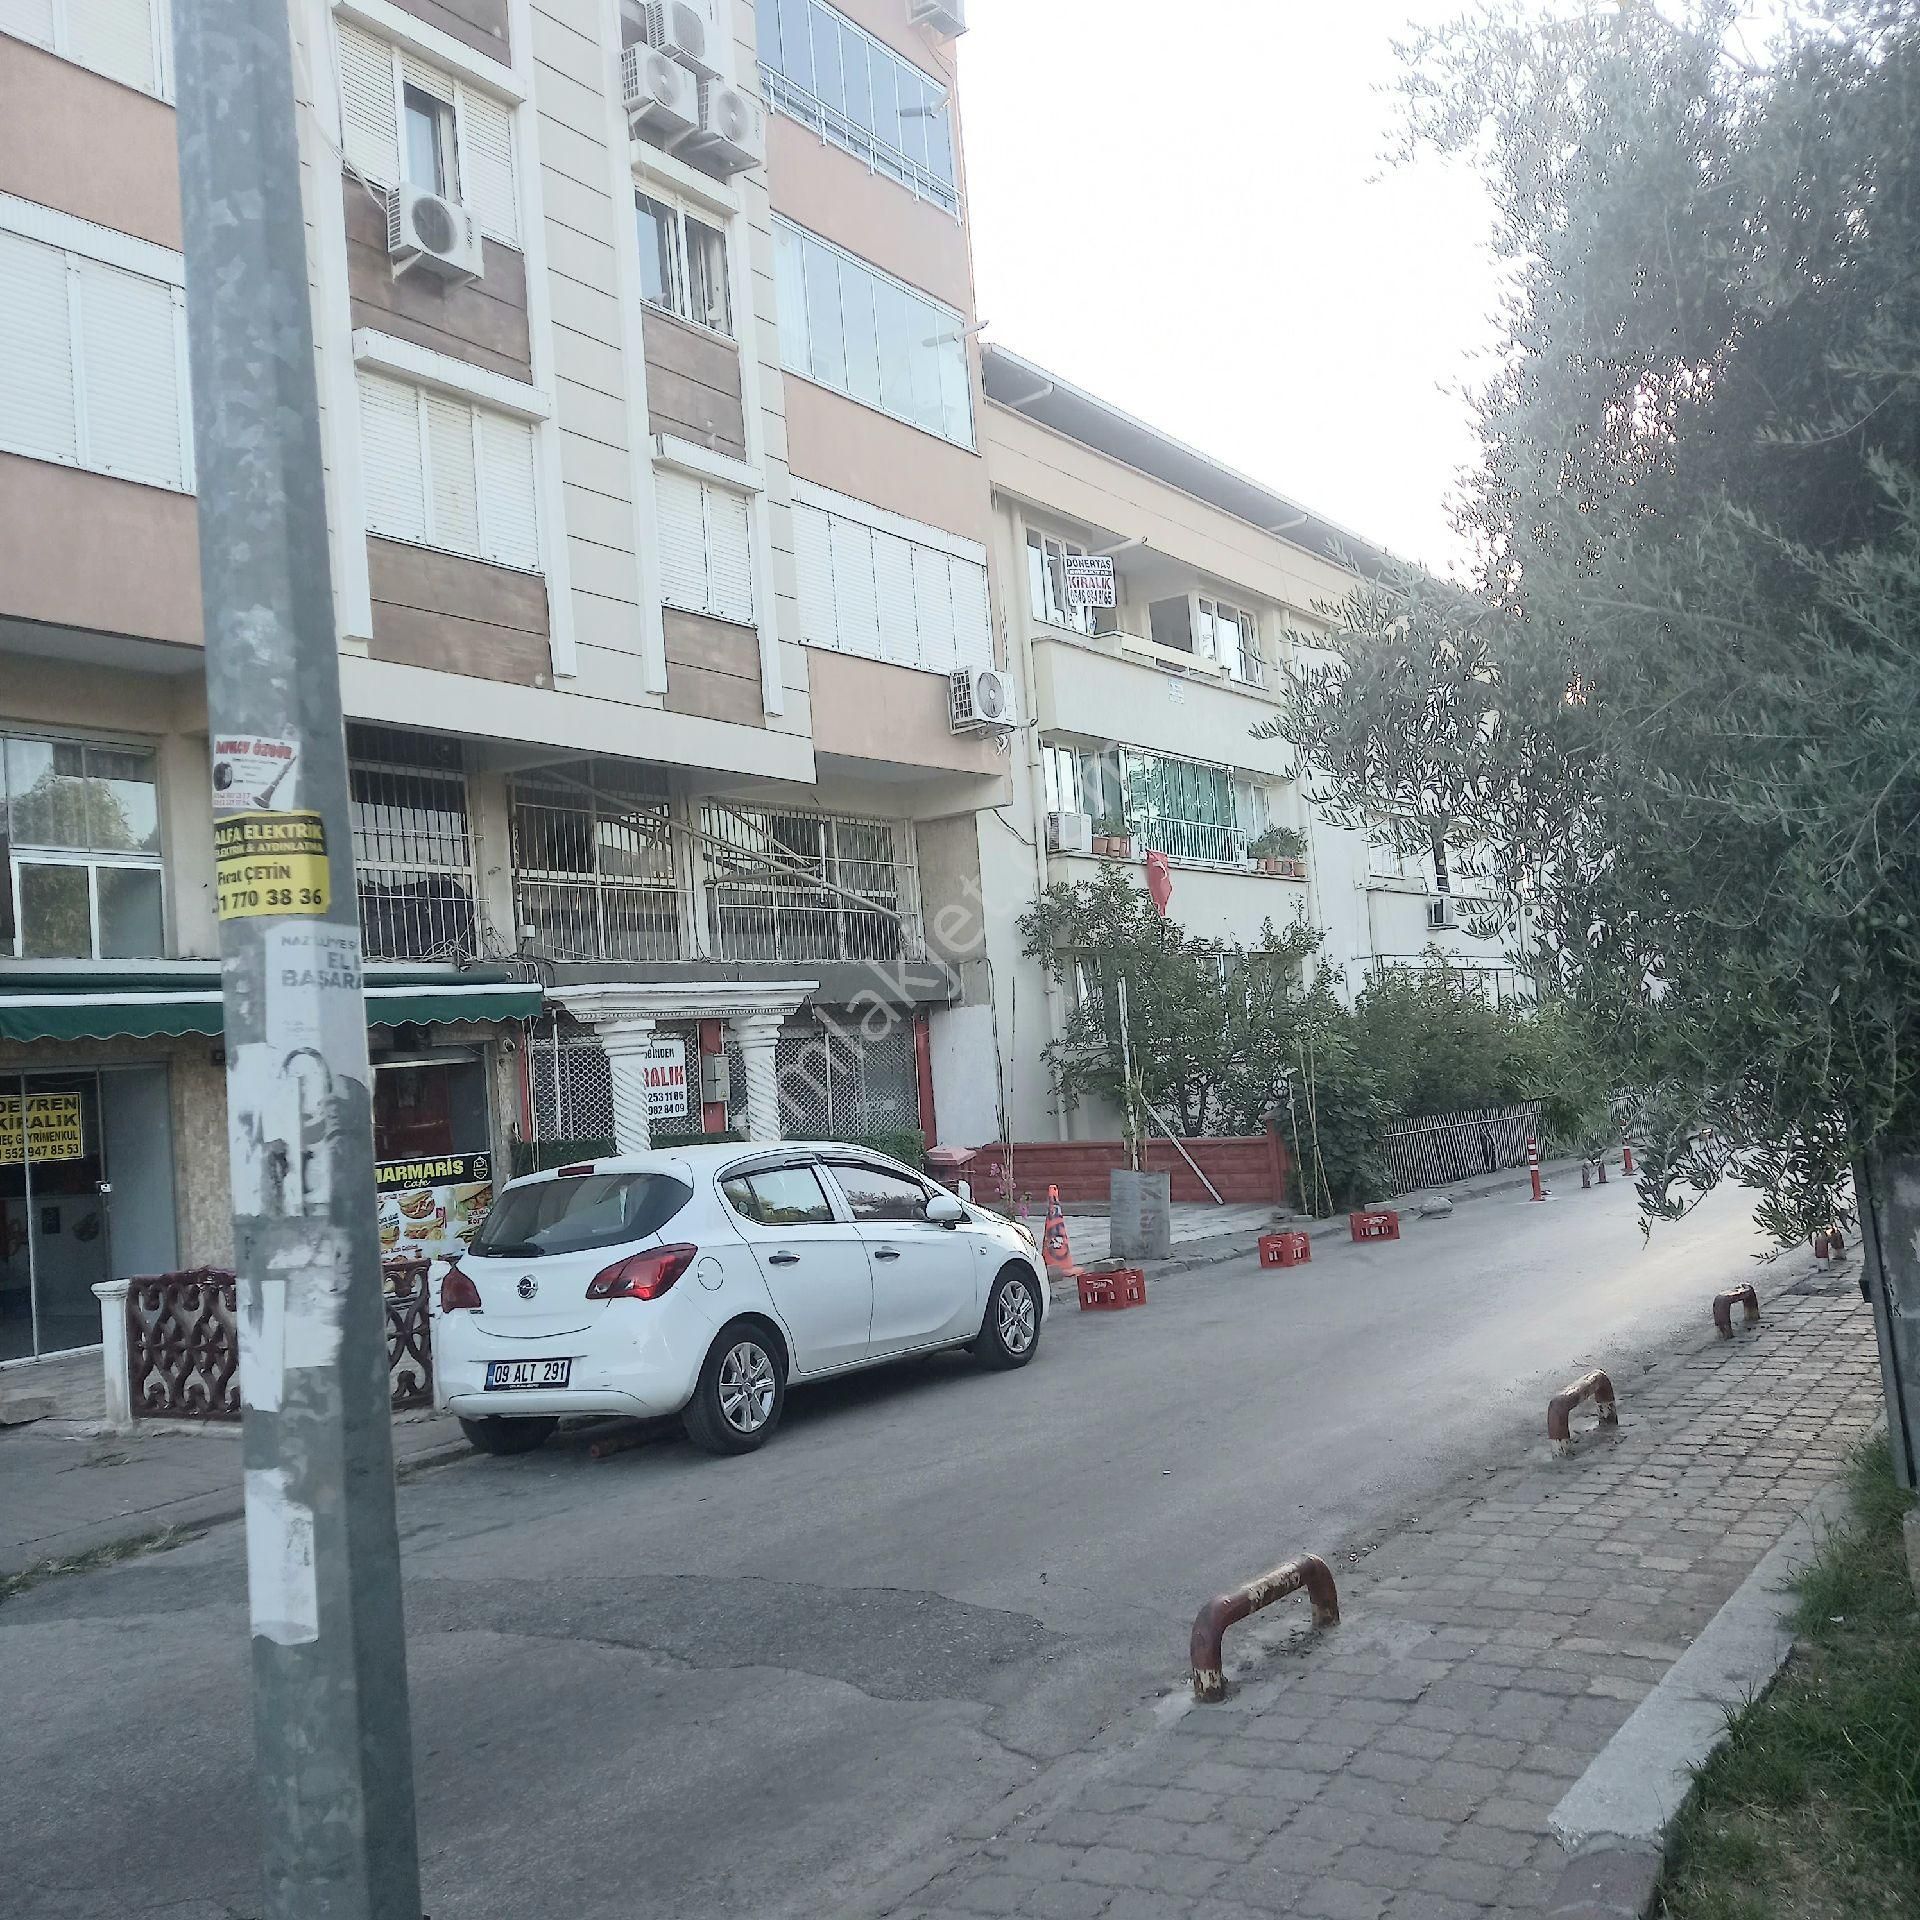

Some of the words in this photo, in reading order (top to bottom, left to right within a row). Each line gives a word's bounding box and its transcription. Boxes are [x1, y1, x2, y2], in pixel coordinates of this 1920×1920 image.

[214, 827, 243, 845] ALFA
[244, 820, 323, 840] ELEKTRİK
[244, 861, 291, 885] ÇETİN
[232, 890, 259, 910] 770
[266, 888, 292, 906] 38
[299, 888, 322, 905] 36
[28, 1145, 48, 1157] 947
[51, 1144, 64, 1155] 85
[67, 1143, 79, 1154] 53
[495, 1365, 509, 1383] 09
[513, 1363, 537, 1382] ALT
[544, 1361, 566, 1381] 291
